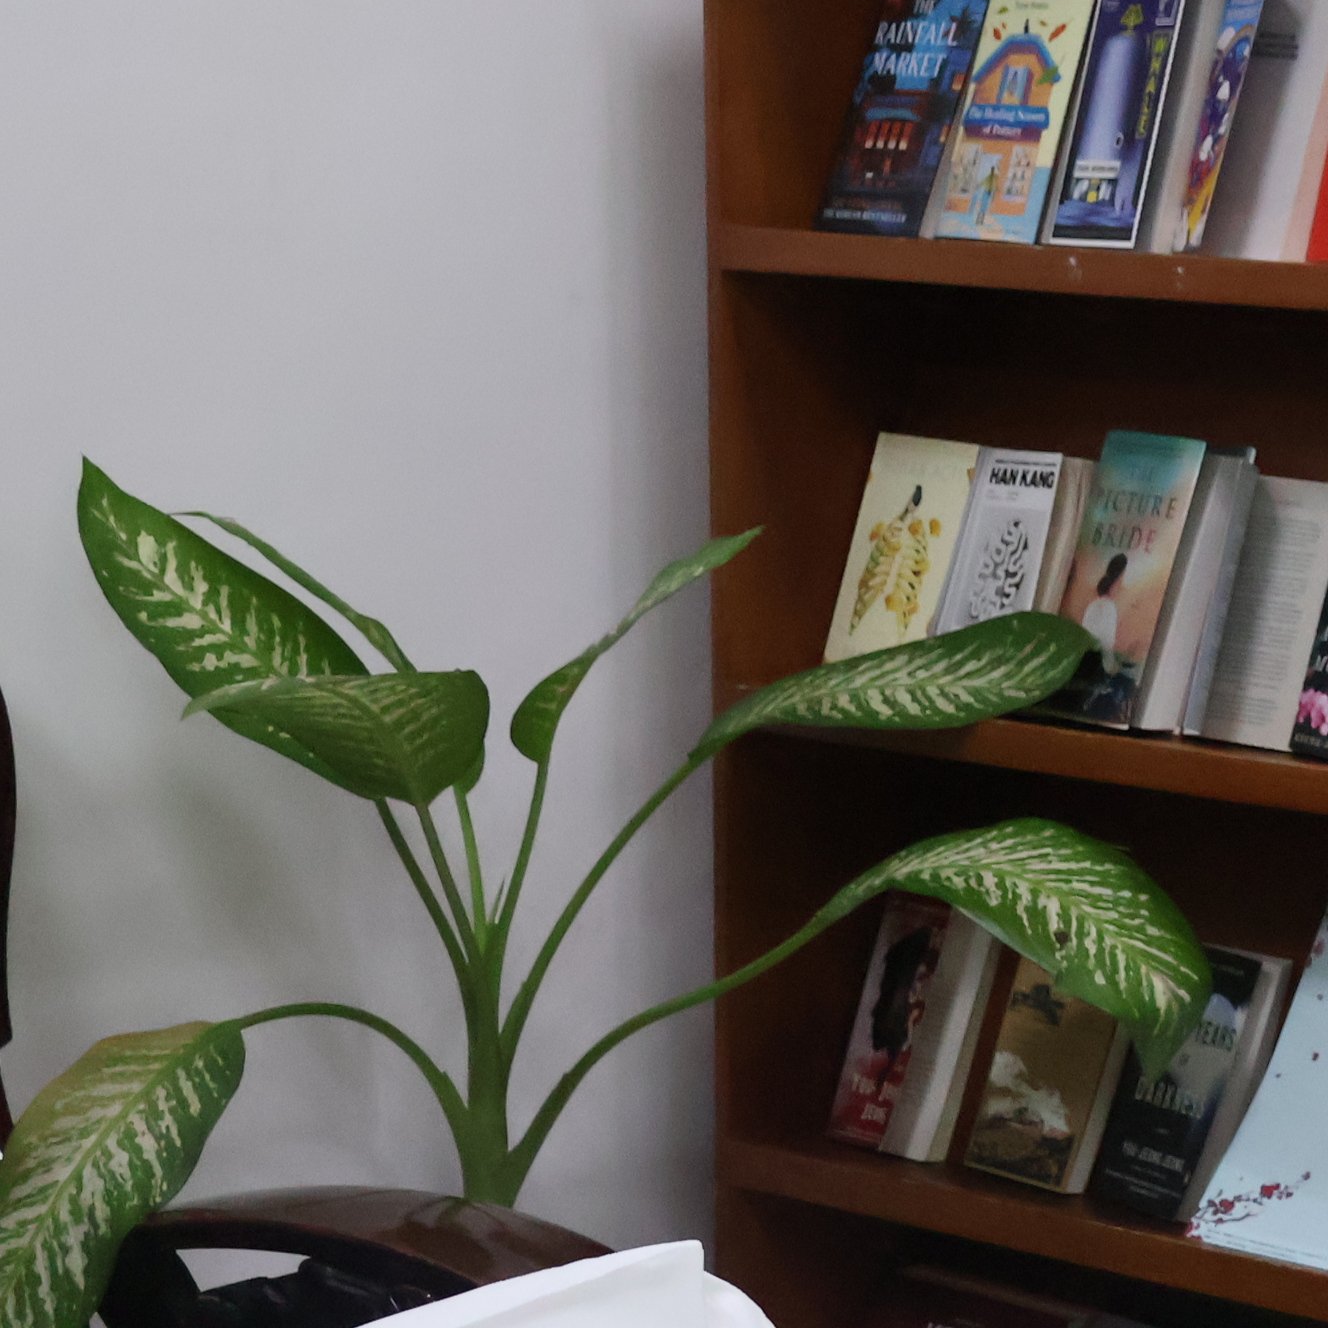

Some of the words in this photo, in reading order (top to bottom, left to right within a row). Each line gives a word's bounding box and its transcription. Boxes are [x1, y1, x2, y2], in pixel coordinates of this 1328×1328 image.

[874, 20, 958, 47] RAINFALL
[871, 51, 948, 78] MARKET
[989, 466, 1017, 487] HAN
[1019, 467, 1056, 490] KANG
